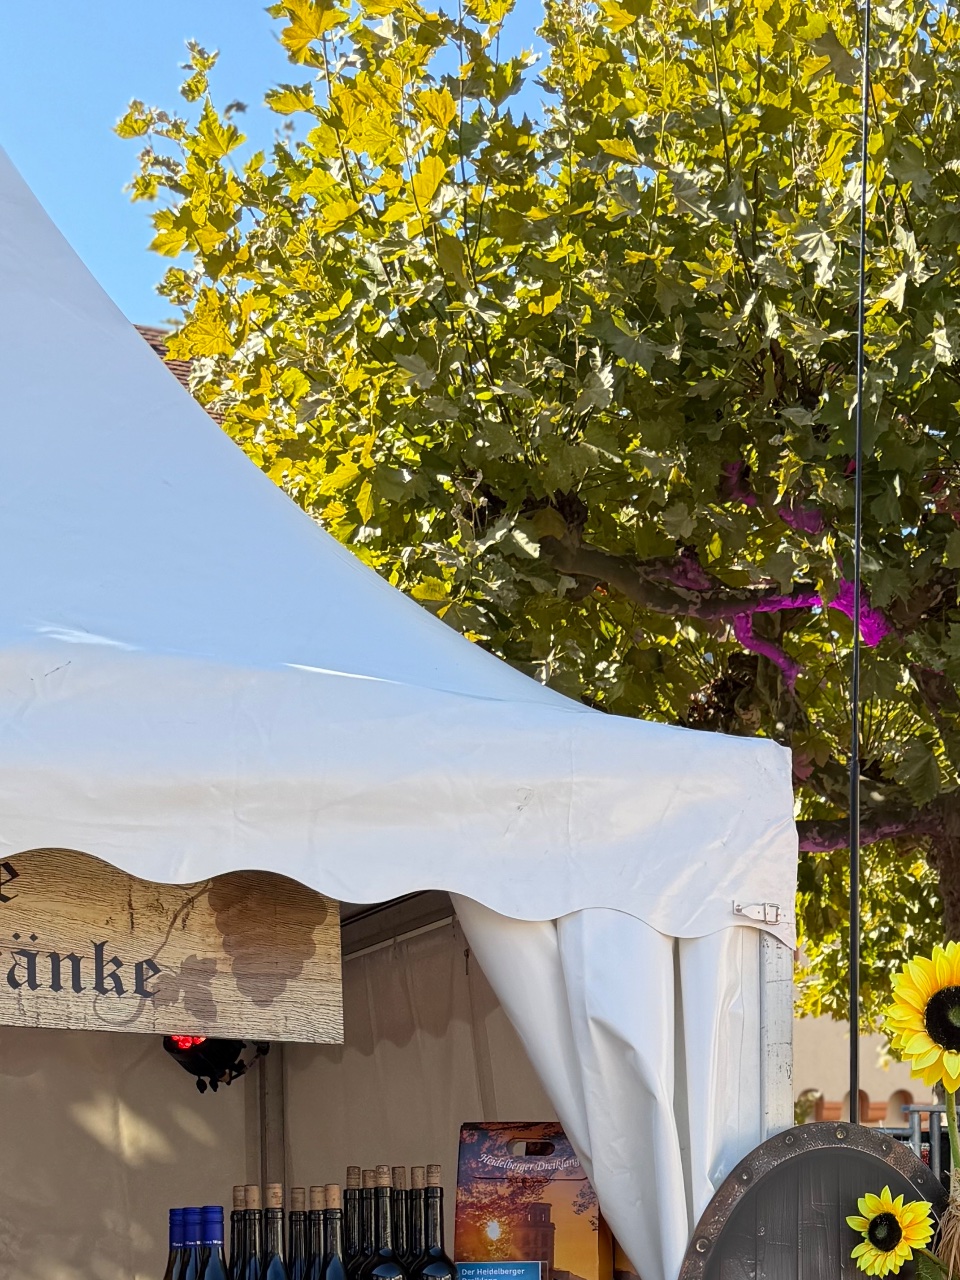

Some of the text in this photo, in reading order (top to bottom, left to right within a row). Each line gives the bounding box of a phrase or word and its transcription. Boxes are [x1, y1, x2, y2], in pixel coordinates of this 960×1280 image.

[0, 932, 162, 998] änke
[478, 1153, 580, 1173] Heidelberger Dreiklang
[461, 1268, 525, 1277] Der Heidelberger
